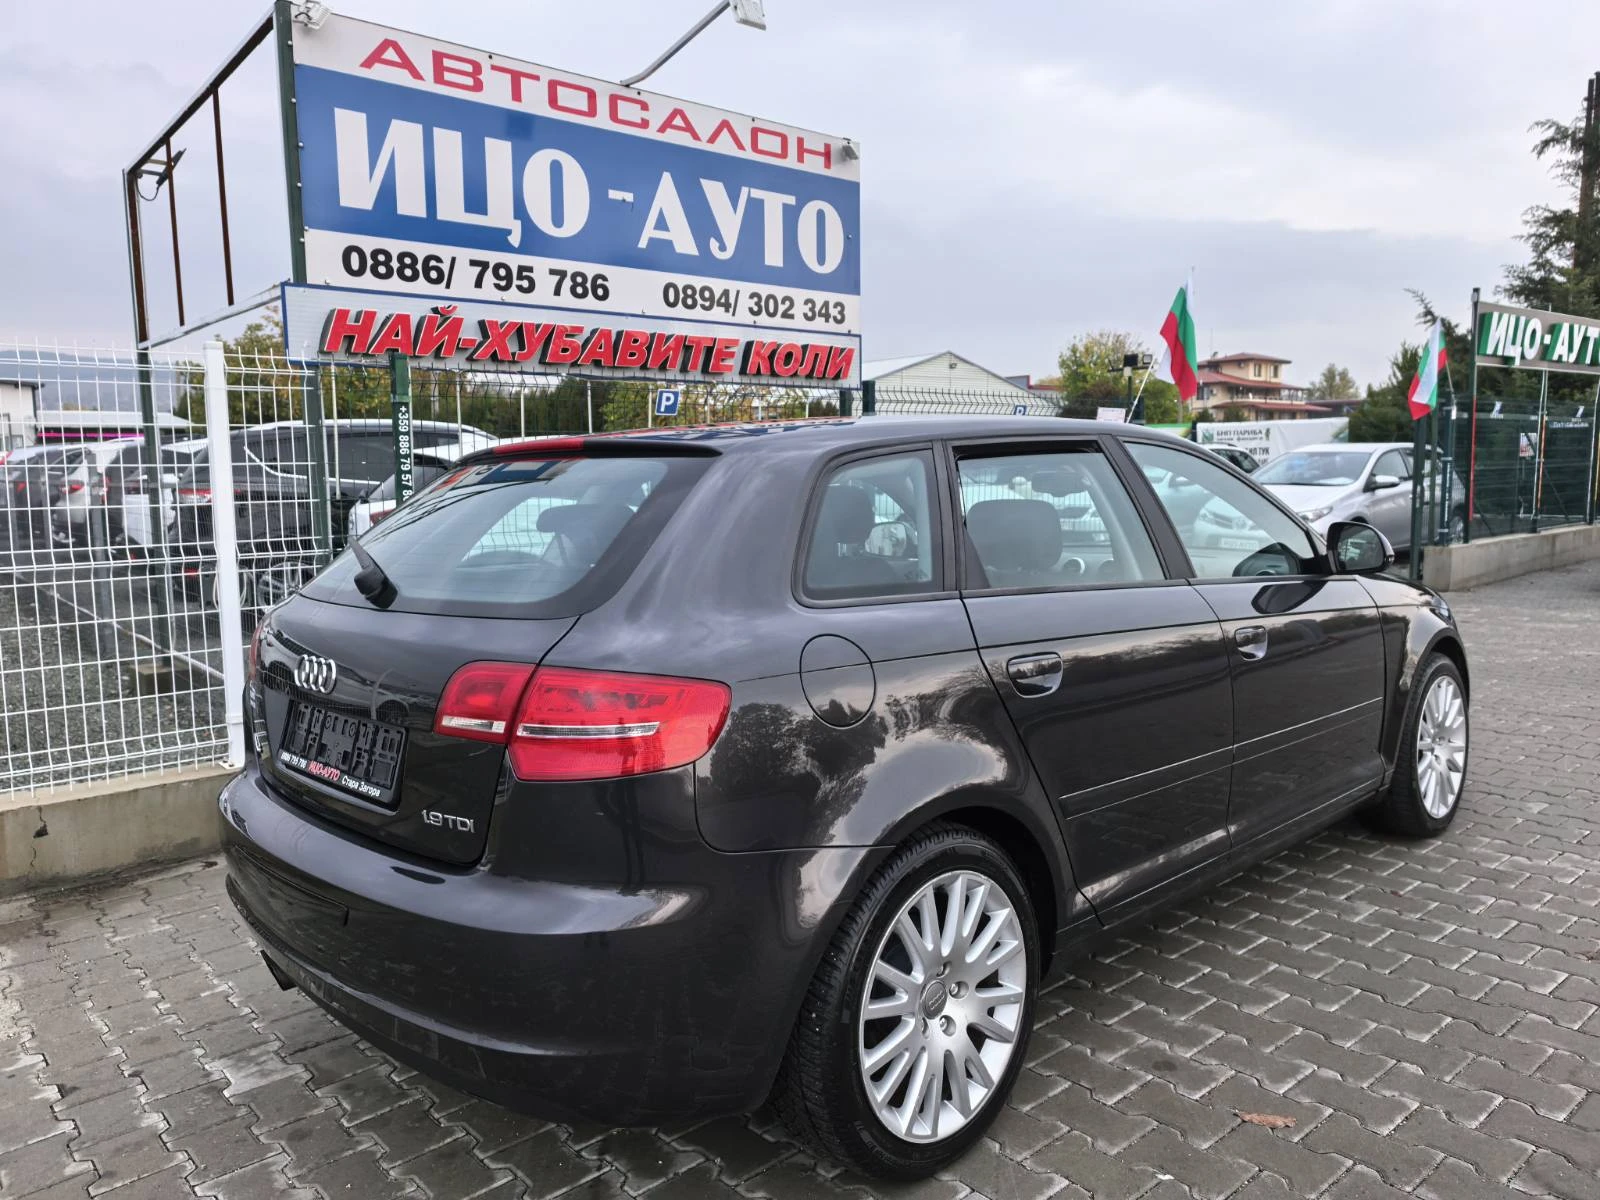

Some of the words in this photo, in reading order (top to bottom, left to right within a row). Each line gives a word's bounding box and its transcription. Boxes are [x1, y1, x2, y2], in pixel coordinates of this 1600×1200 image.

[359, 37, 832, 170] АВТОСАЛОН
[342, 244, 457, 290] 0886/
[469, 259, 536, 294] 795
[549, 268, 610, 302] 786
[663, 282, 740, 317] 0894/
[748, 291, 795, 320] 302
[803, 297, 846, 325] 343
[322, 304, 740, 374] НАЙ-ХУБАВИТЕ
[744, 339, 854, 380] КОЛИ
[1486, 311, 1600, 366] ИЦО-АУТ
[661, 393, 674, 412] P
[398, 405, 409, 432] +359
[398, 435, 410, 455] 886
[400, 458, 411, 471] 79
[401, 473, 412, 487] 57
[341, 775, 359, 790] Стара
[358, 781, 381, 797] Загора
